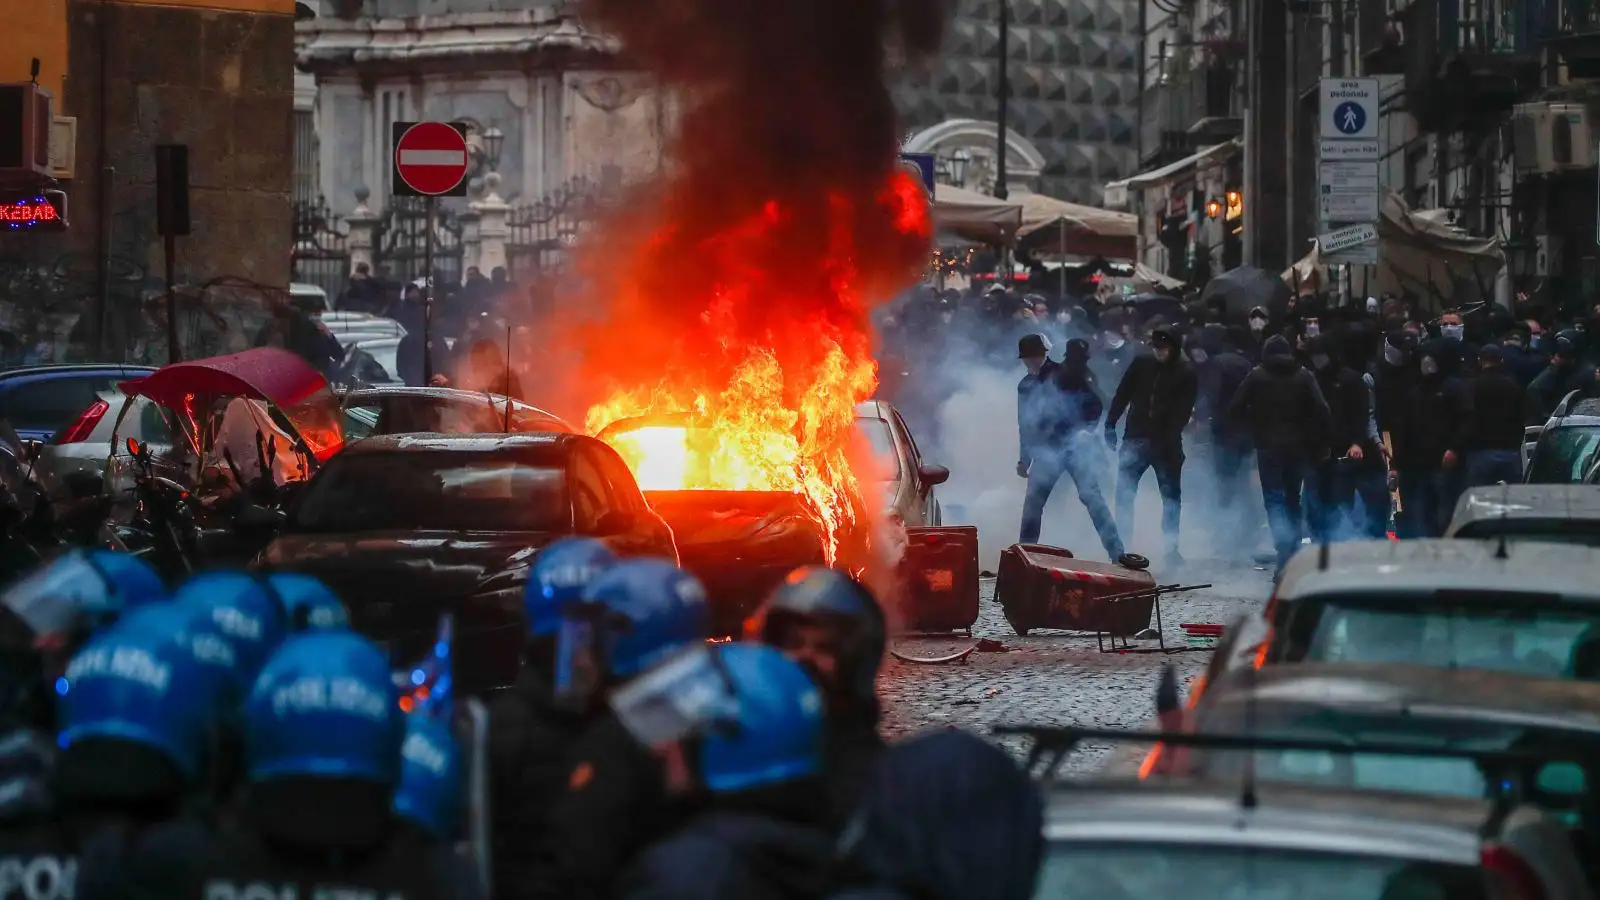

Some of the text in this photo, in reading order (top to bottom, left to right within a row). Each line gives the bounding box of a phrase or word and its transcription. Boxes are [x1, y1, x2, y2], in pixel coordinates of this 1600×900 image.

[1330, 90, 1369, 98] pedonale
[0, 205, 54, 219] KEBAB
[1331, 227, 1362, 240] controllo
[1325, 235, 1361, 249] elettronico
